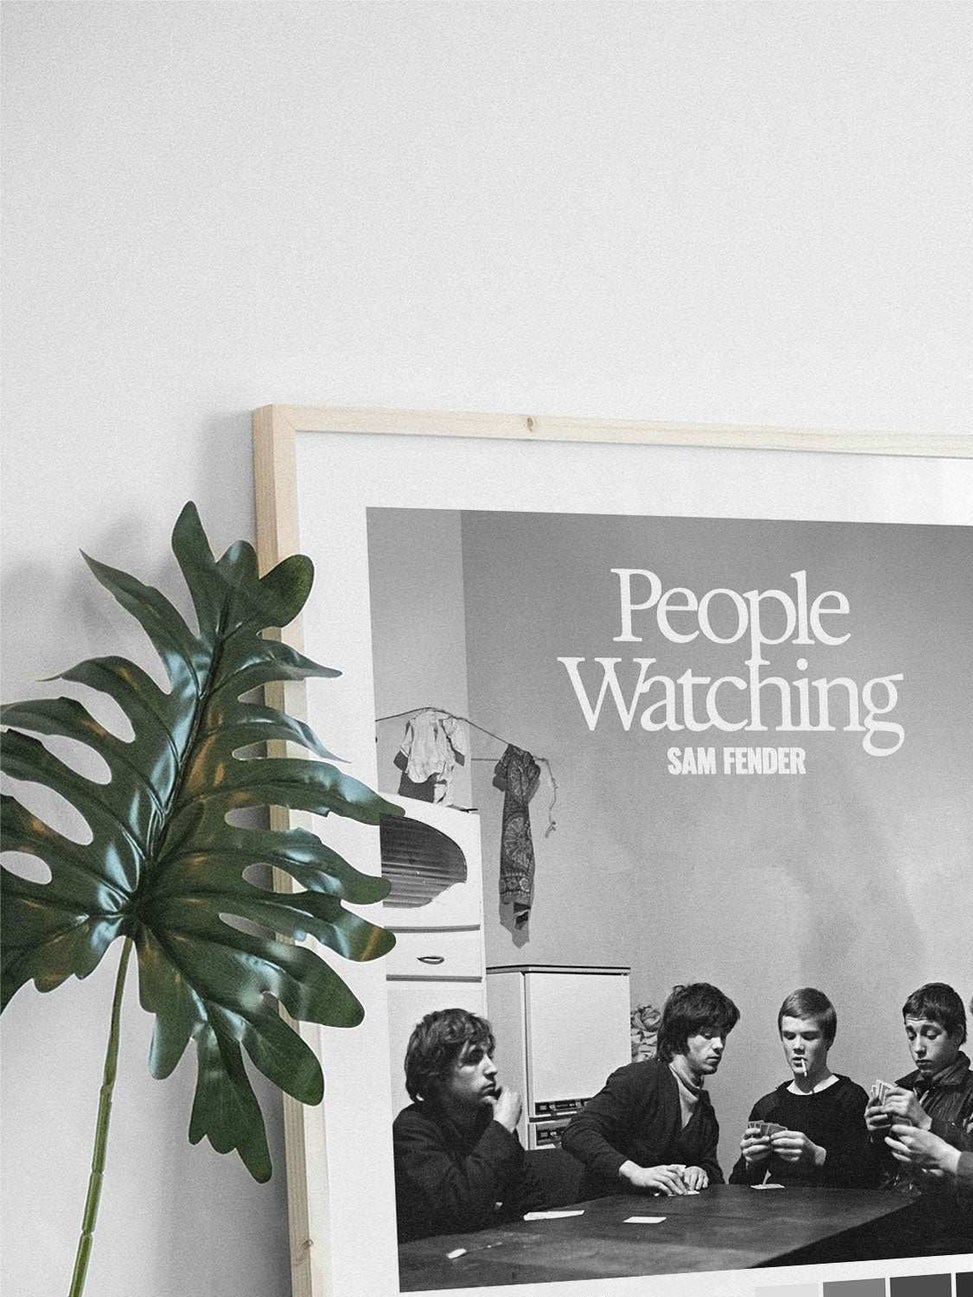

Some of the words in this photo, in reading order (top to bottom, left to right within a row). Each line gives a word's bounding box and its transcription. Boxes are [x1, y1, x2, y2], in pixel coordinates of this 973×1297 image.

[610, 567, 851, 666] People
[557, 657, 905, 757] Watching
[667, 746, 718, 775] SAM
[723, 746, 807, 775] FENDER
